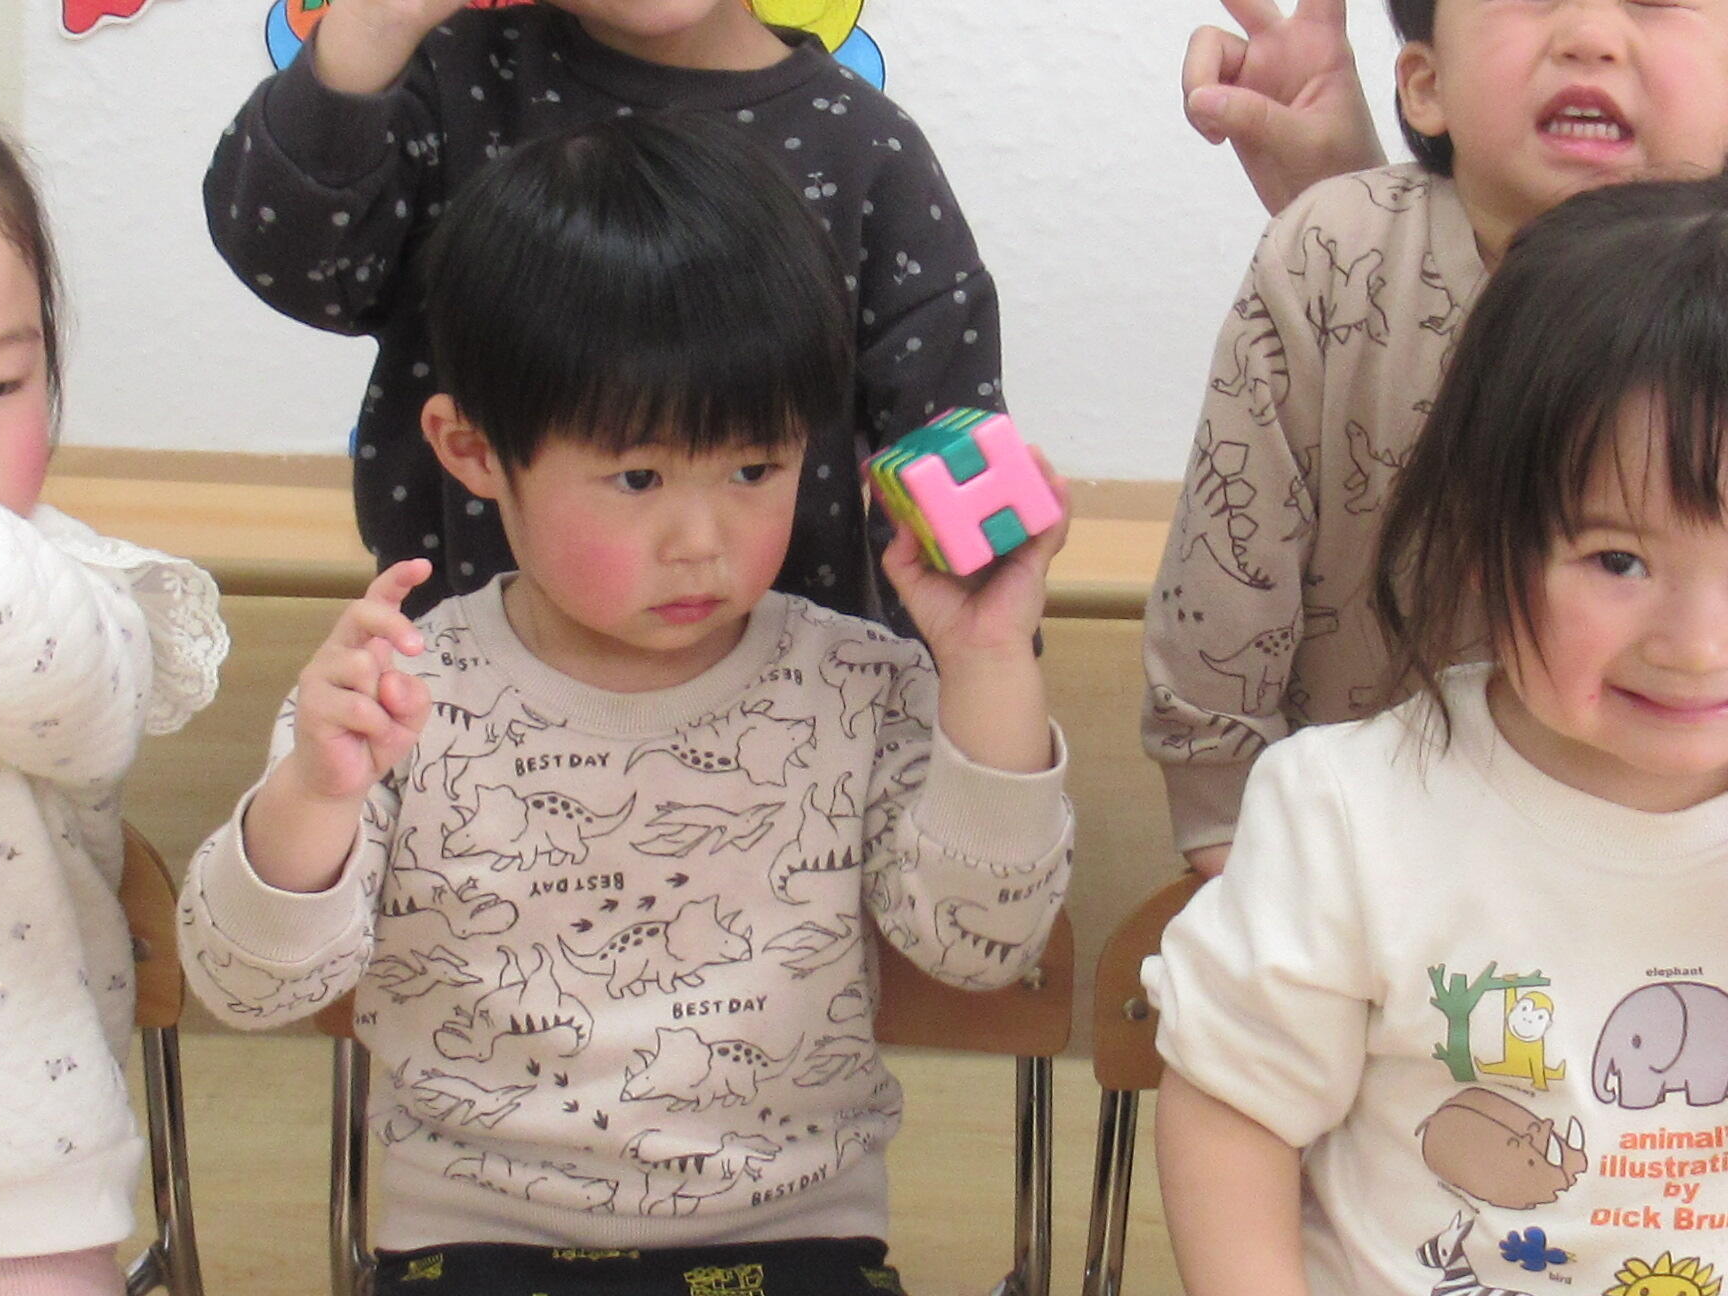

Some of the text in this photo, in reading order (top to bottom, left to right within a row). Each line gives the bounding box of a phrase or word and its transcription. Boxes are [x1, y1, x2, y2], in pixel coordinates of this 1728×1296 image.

[441, 651, 479, 671] BST
[515, 751, 611, 777] BEST DAY
[529, 871, 624, 898] BEST DAY
[1645, 966, 1705, 978] elephant
[672, 994, 768, 1020] BEST DAY
[751, 1163, 828, 1207] BEST DAY
[1663, 1180, 1701, 1204] by
[1590, 1205, 1662, 1230] Dick
